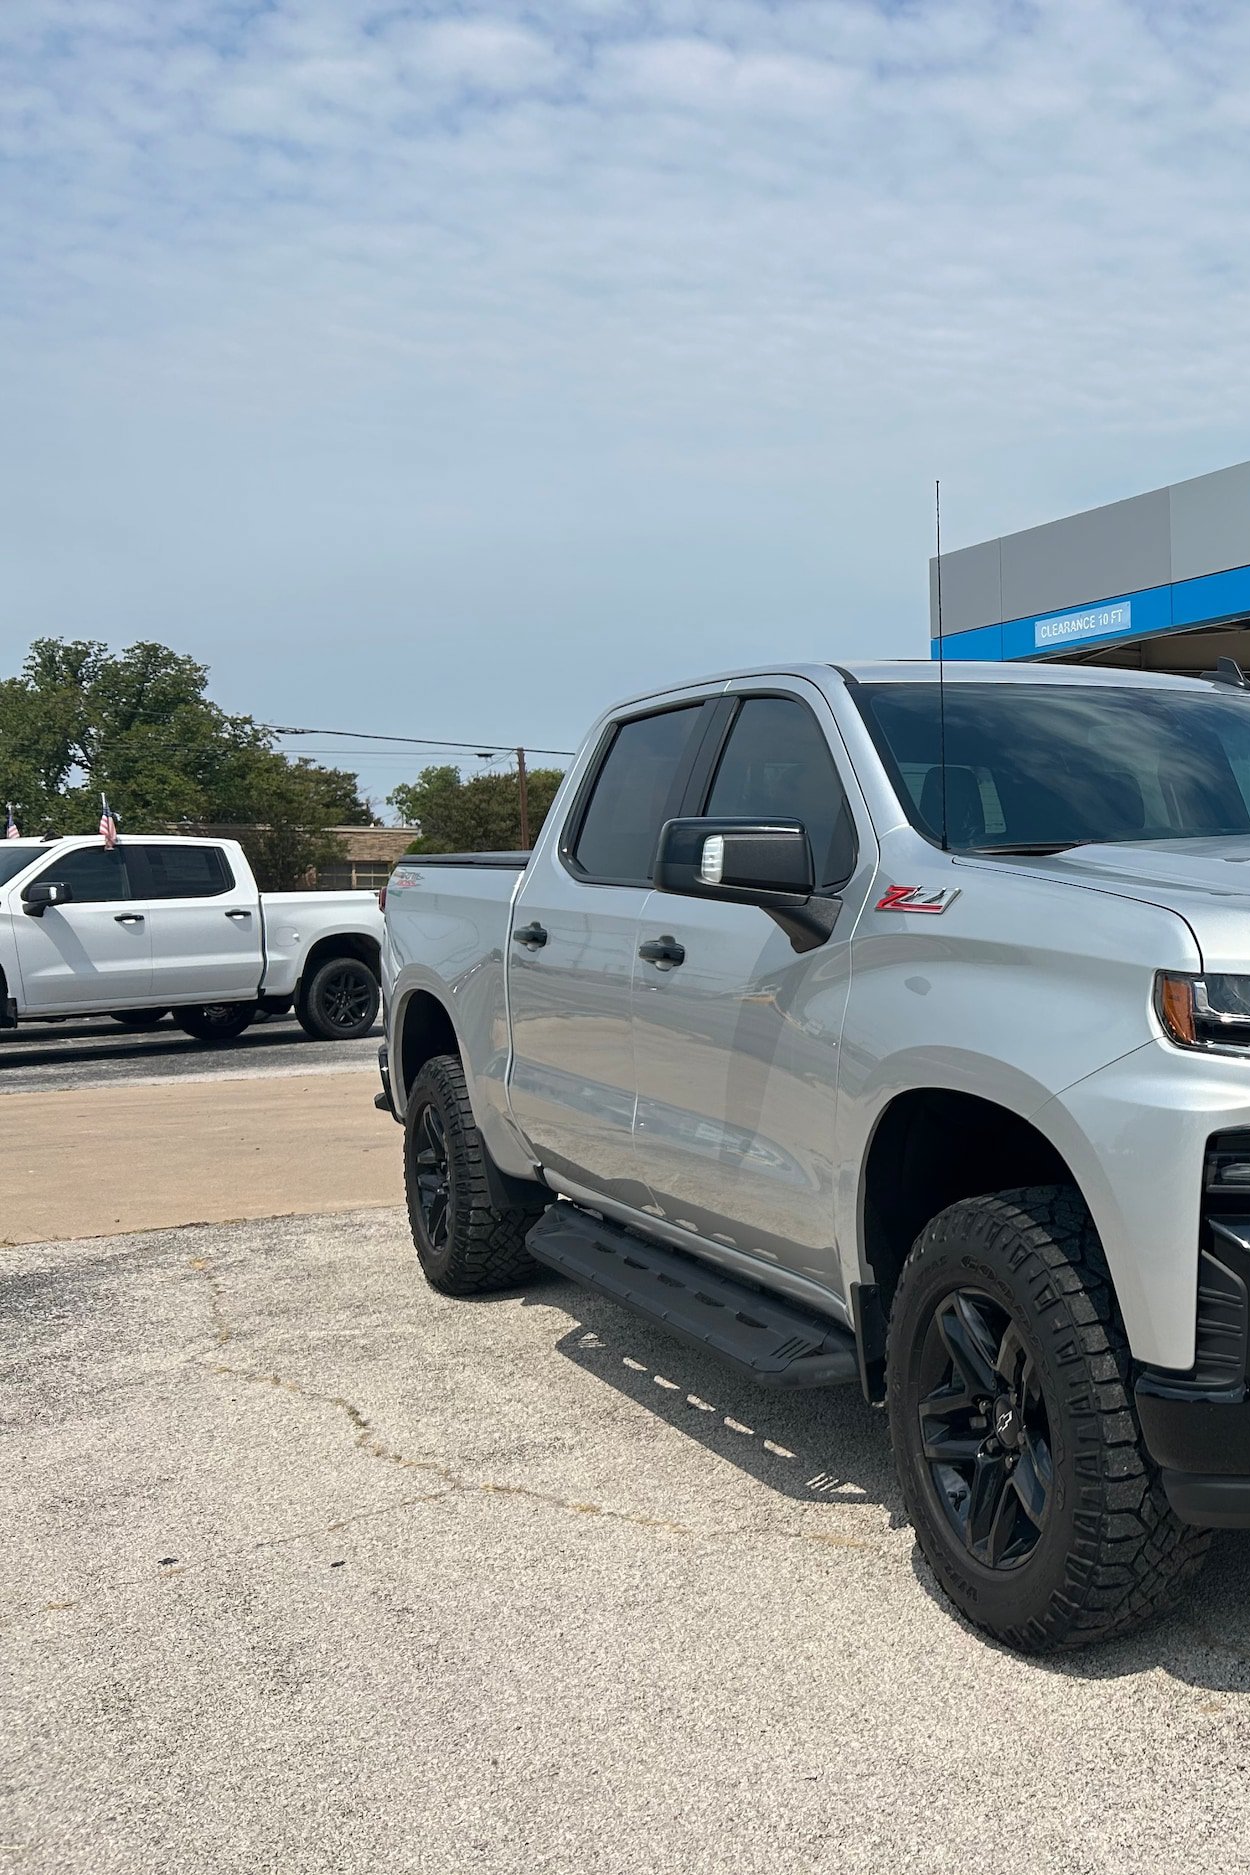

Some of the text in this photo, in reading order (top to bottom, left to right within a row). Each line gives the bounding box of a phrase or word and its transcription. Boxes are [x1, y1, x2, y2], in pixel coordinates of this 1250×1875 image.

[1041, 609, 1123, 638] CLEARANCE 10 FT
